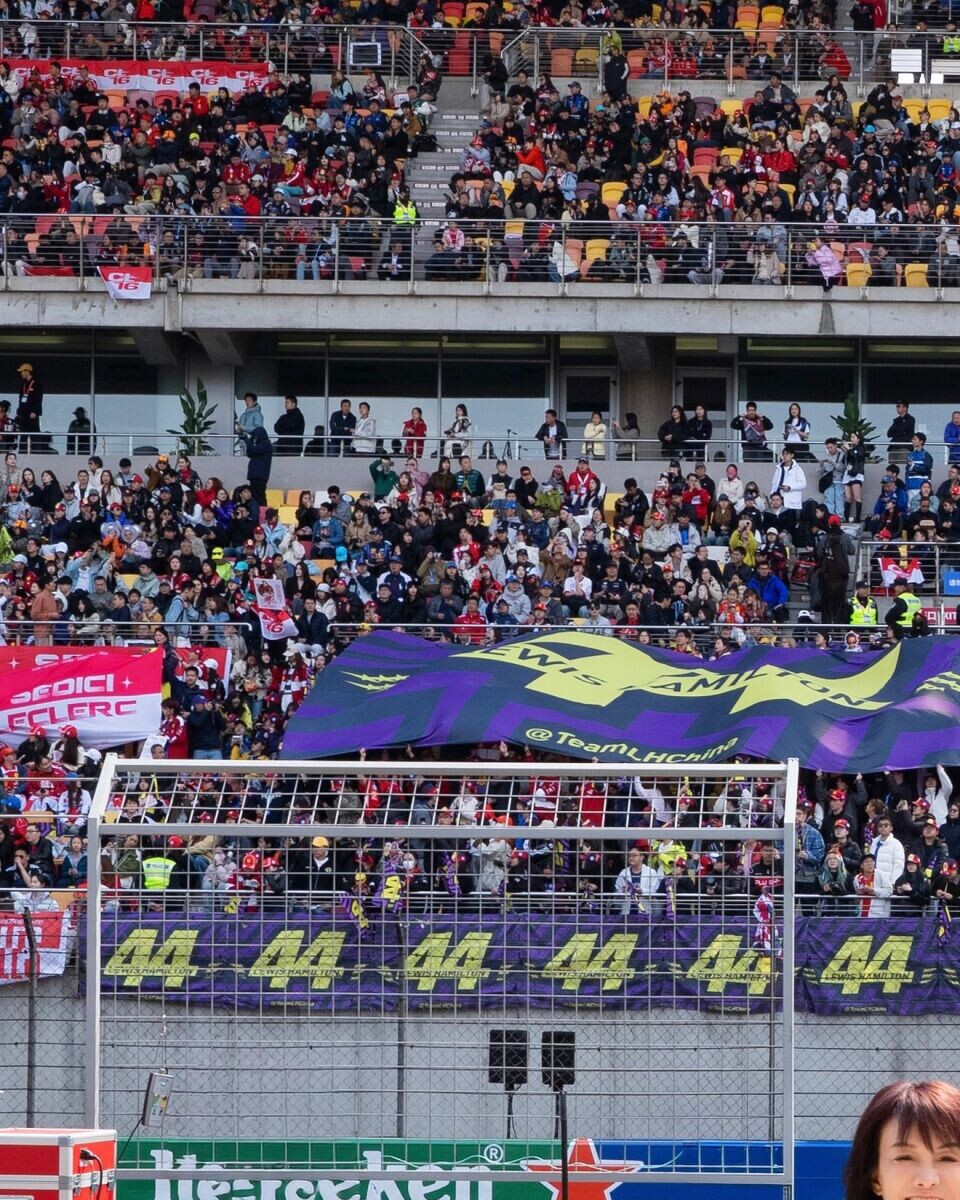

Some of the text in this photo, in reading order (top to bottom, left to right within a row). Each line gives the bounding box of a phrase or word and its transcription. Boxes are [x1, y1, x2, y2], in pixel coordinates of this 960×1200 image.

[104, 929, 199, 987] 44
[248, 930, 346, 989] 44
[404, 932, 493, 990] 44
[541, 933, 639, 991] 44
[819, 935, 914, 995] 44
[825, 972, 911, 981] LEWIS HAMILTON
